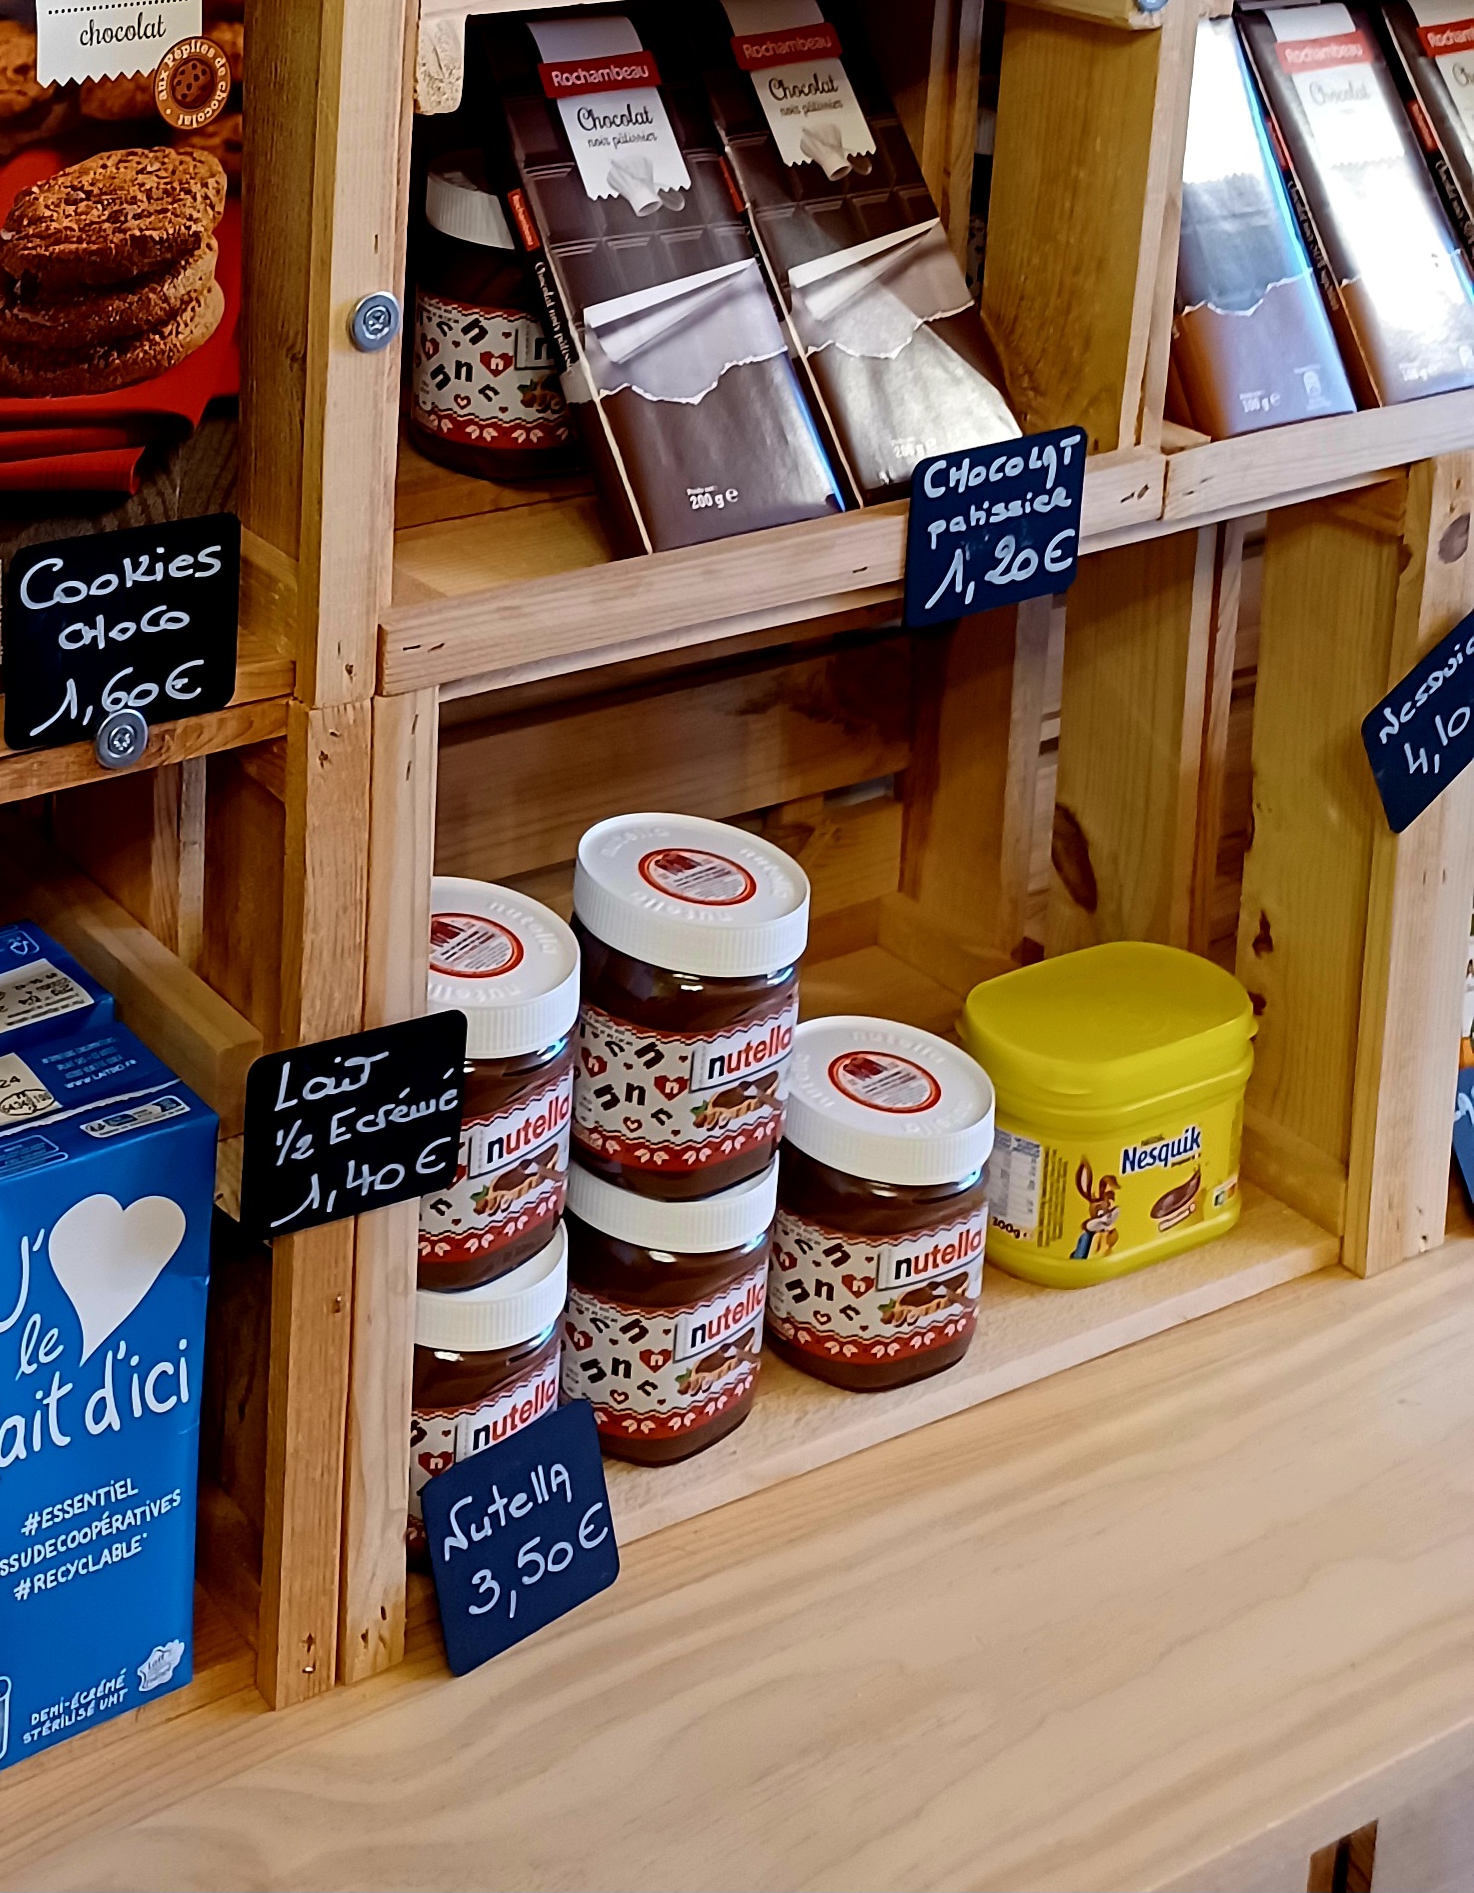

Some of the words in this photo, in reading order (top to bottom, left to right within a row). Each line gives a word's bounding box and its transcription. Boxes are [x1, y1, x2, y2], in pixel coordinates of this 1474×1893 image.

[78, 11, 167, 48] chocolat
[742, 32, 832, 60] Rochambeau
[551, 64, 650, 88] Rochambeau
[767, 73, 840, 103] Chocolat
[575, 103, 654, 132] Chocolat
[689, 492, 714, 510] 200
[19, 544, 222, 610] Cookies
[706, 1023, 794, 1083] nutella
[486, 1091, 572, 1166] nutella
[1121, 1125, 1202, 1175] Nesquik
[893, 1226, 984, 1283] nutella
[689, 1282, 767, 1350] nutella
[14, 1312, 65, 1382] le
[83, 1338, 191, 1436] d'ici
[471, 1378, 556, 1452] nutella
